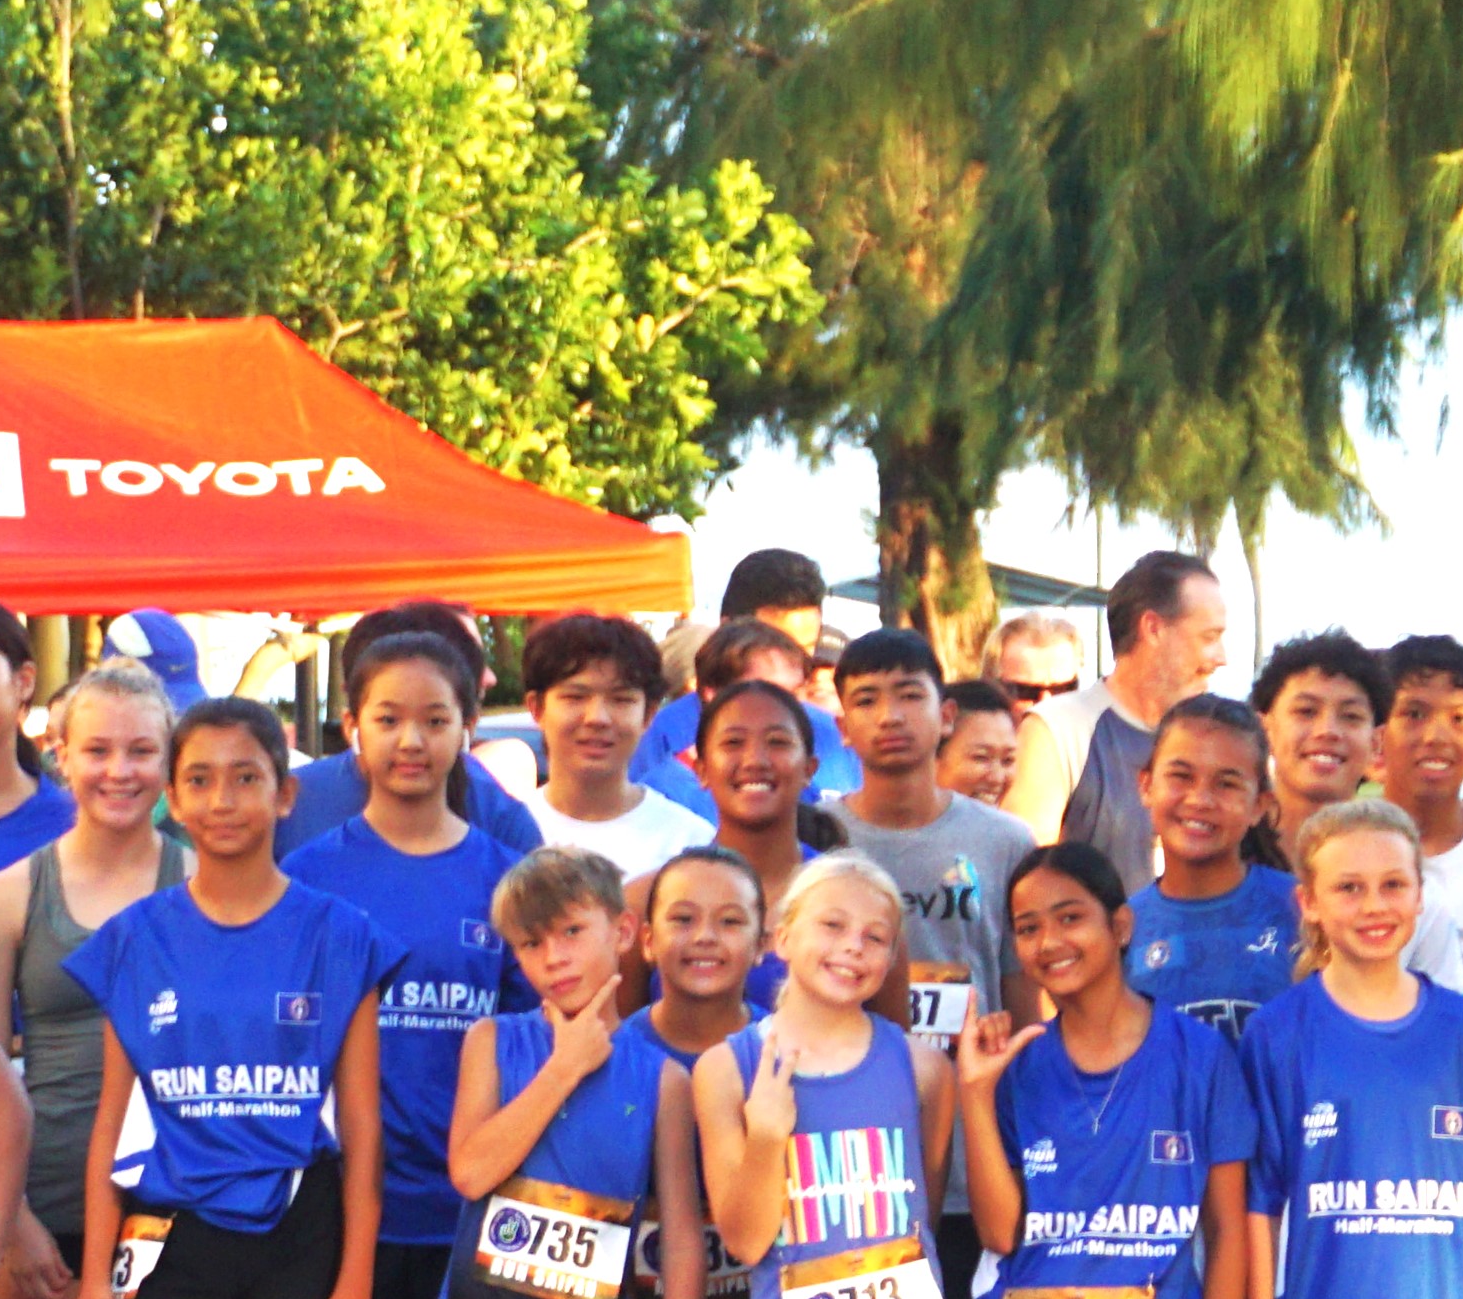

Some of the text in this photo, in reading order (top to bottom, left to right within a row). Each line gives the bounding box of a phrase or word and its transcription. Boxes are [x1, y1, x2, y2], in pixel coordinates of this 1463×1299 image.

[49, 456, 386, 497] TOYOTA
[151, 1064, 320, 1097] RUN SAIPAN
[180, 1101, 302, 1118] Half-Marathon
[1307, 1180, 1367, 1212] RUN
[1024, 1203, 1200, 1241] RUN SAIPAN
[527, 1213, 600, 1269] 735
[1047, 1239, 1177, 1258] Half-Marathon
[489, 1256, 599, 1299] RUN SAIPAN
